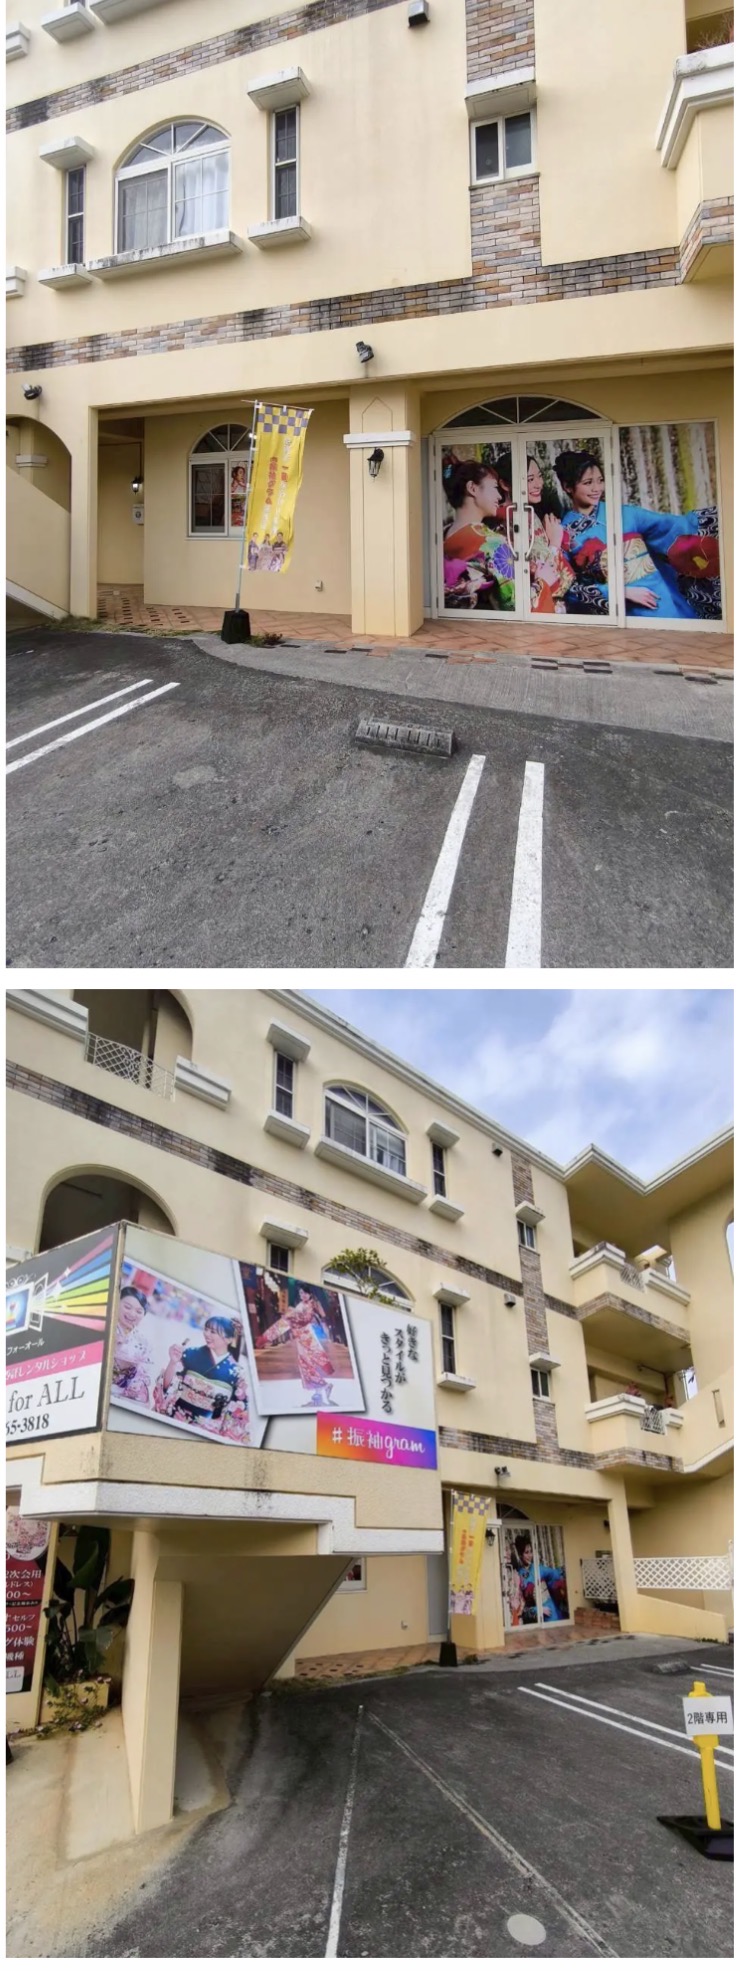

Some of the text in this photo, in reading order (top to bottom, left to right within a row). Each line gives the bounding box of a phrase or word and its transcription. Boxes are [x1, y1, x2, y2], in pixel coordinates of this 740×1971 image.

[394, 1328, 407, 1384] スタイルが
[406, 1323, 419, 1363] 好きな
[380, 1331, 393, 1414] きっと見つかる
[8, 1376, 85, 1413] for ALL
[687, 1711, 728, 1725] 2階専用
